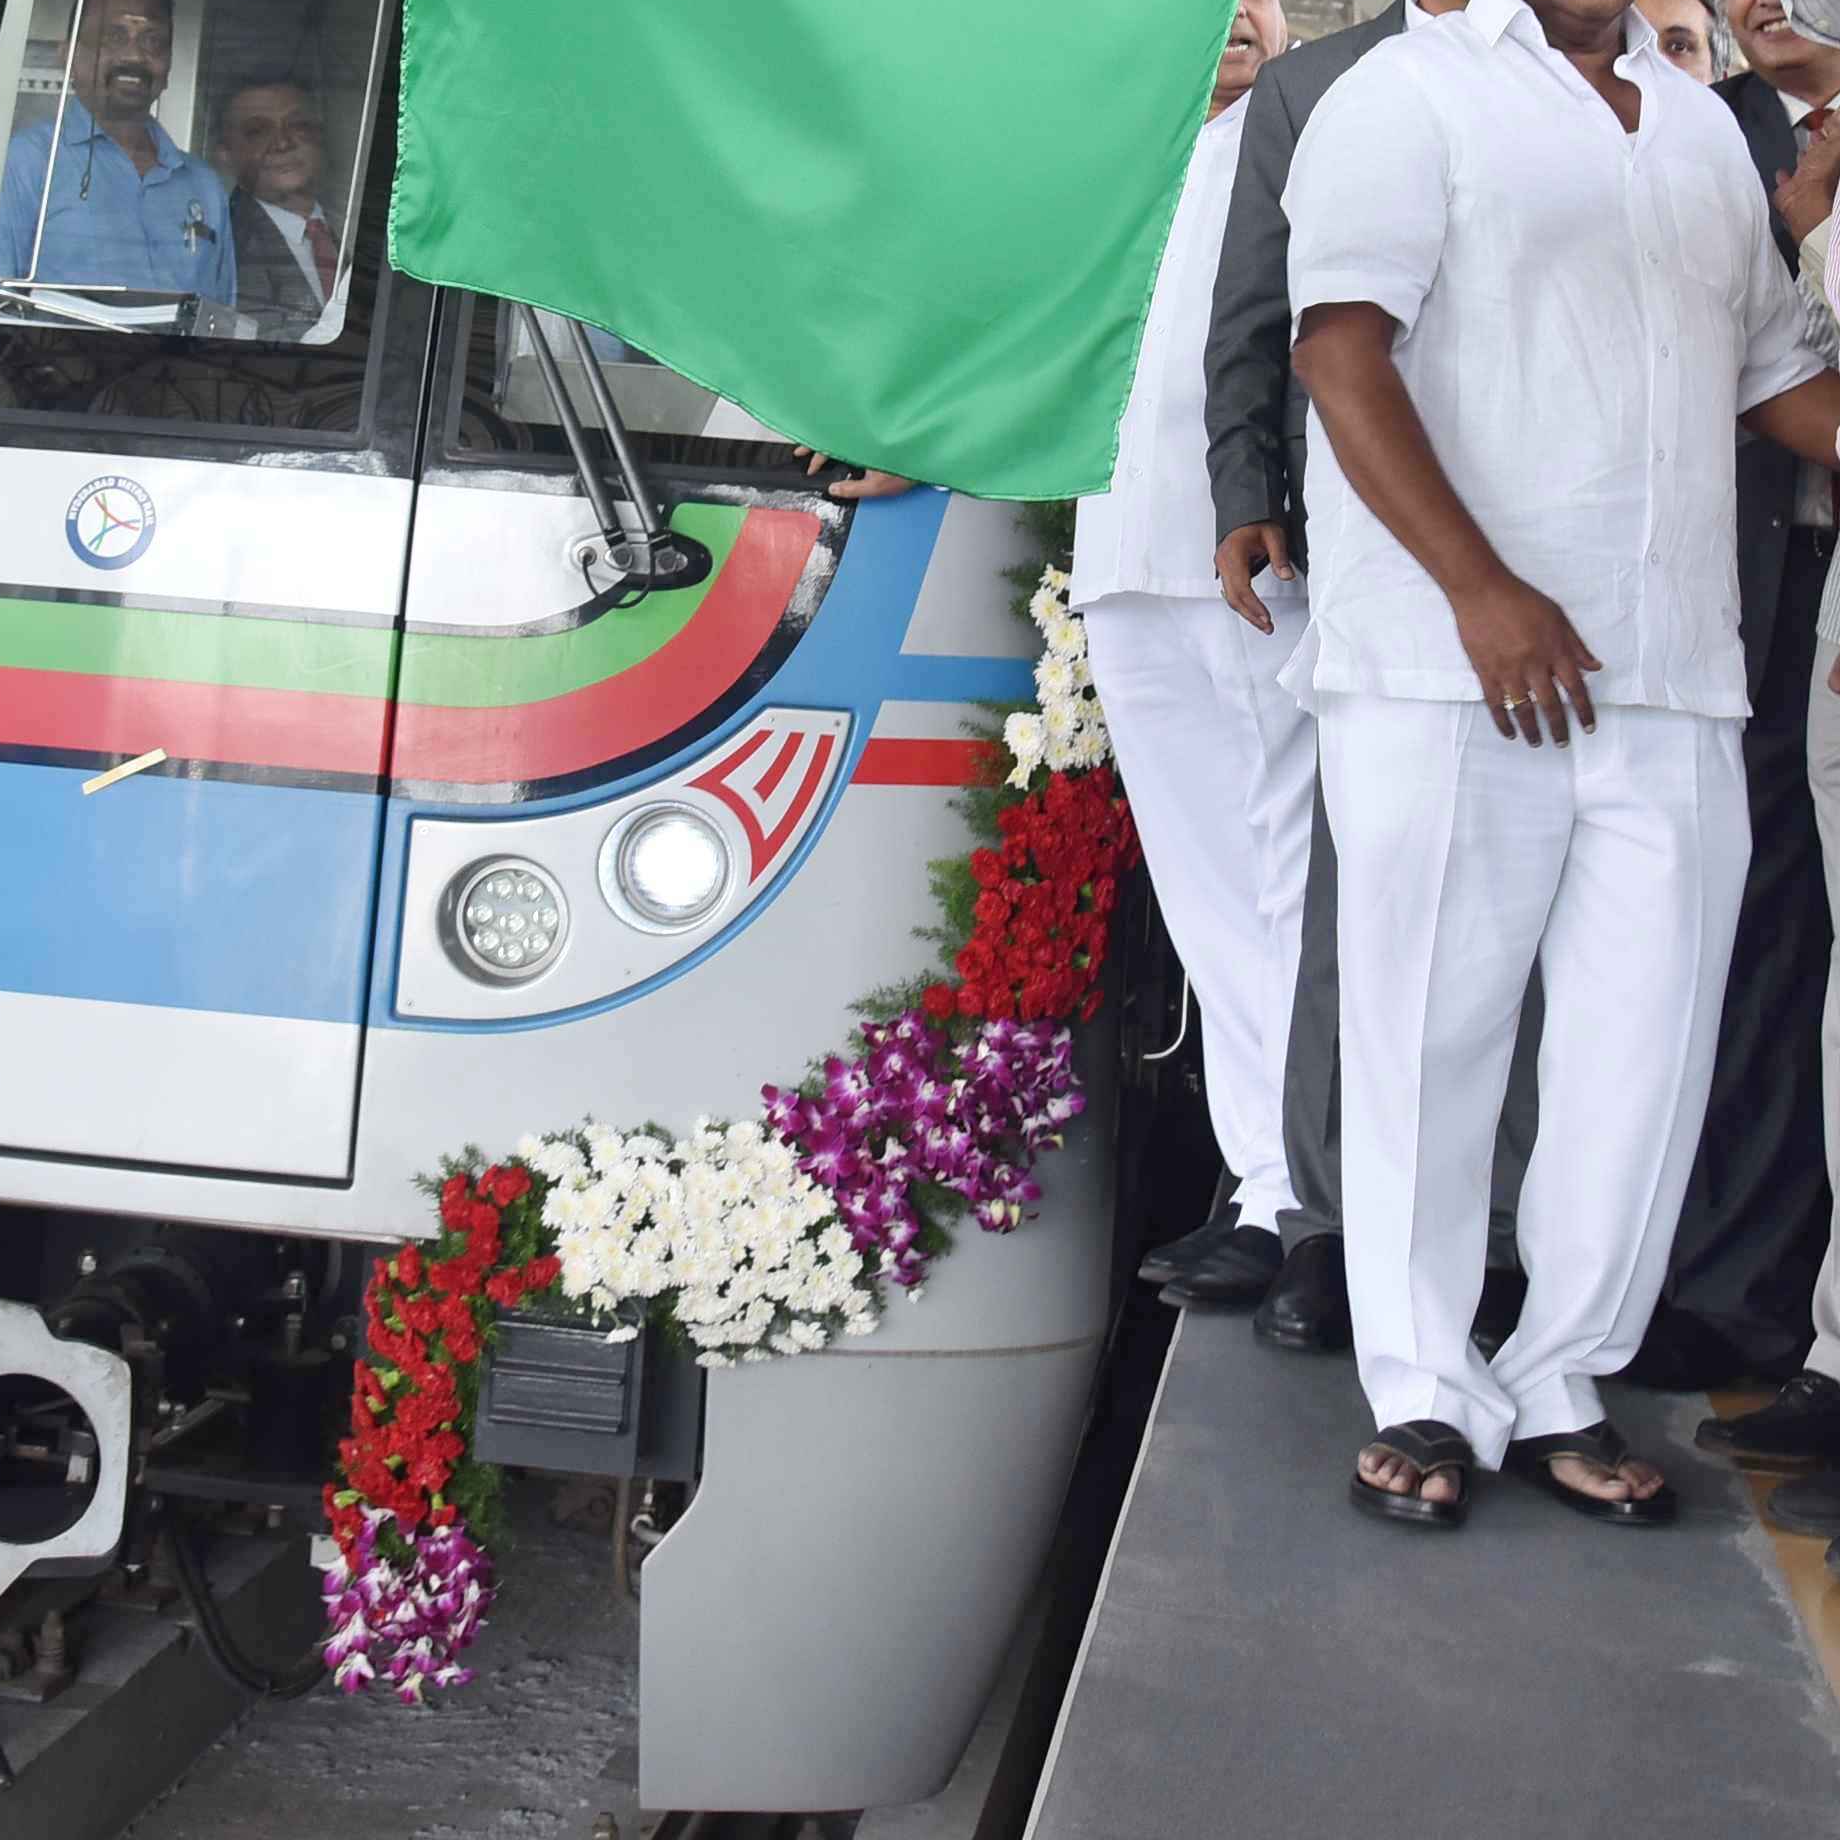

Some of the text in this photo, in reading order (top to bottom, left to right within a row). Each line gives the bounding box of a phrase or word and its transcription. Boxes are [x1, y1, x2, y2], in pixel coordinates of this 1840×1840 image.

[68, 477, 155, 527] HYDERABAD METRO RAIL
